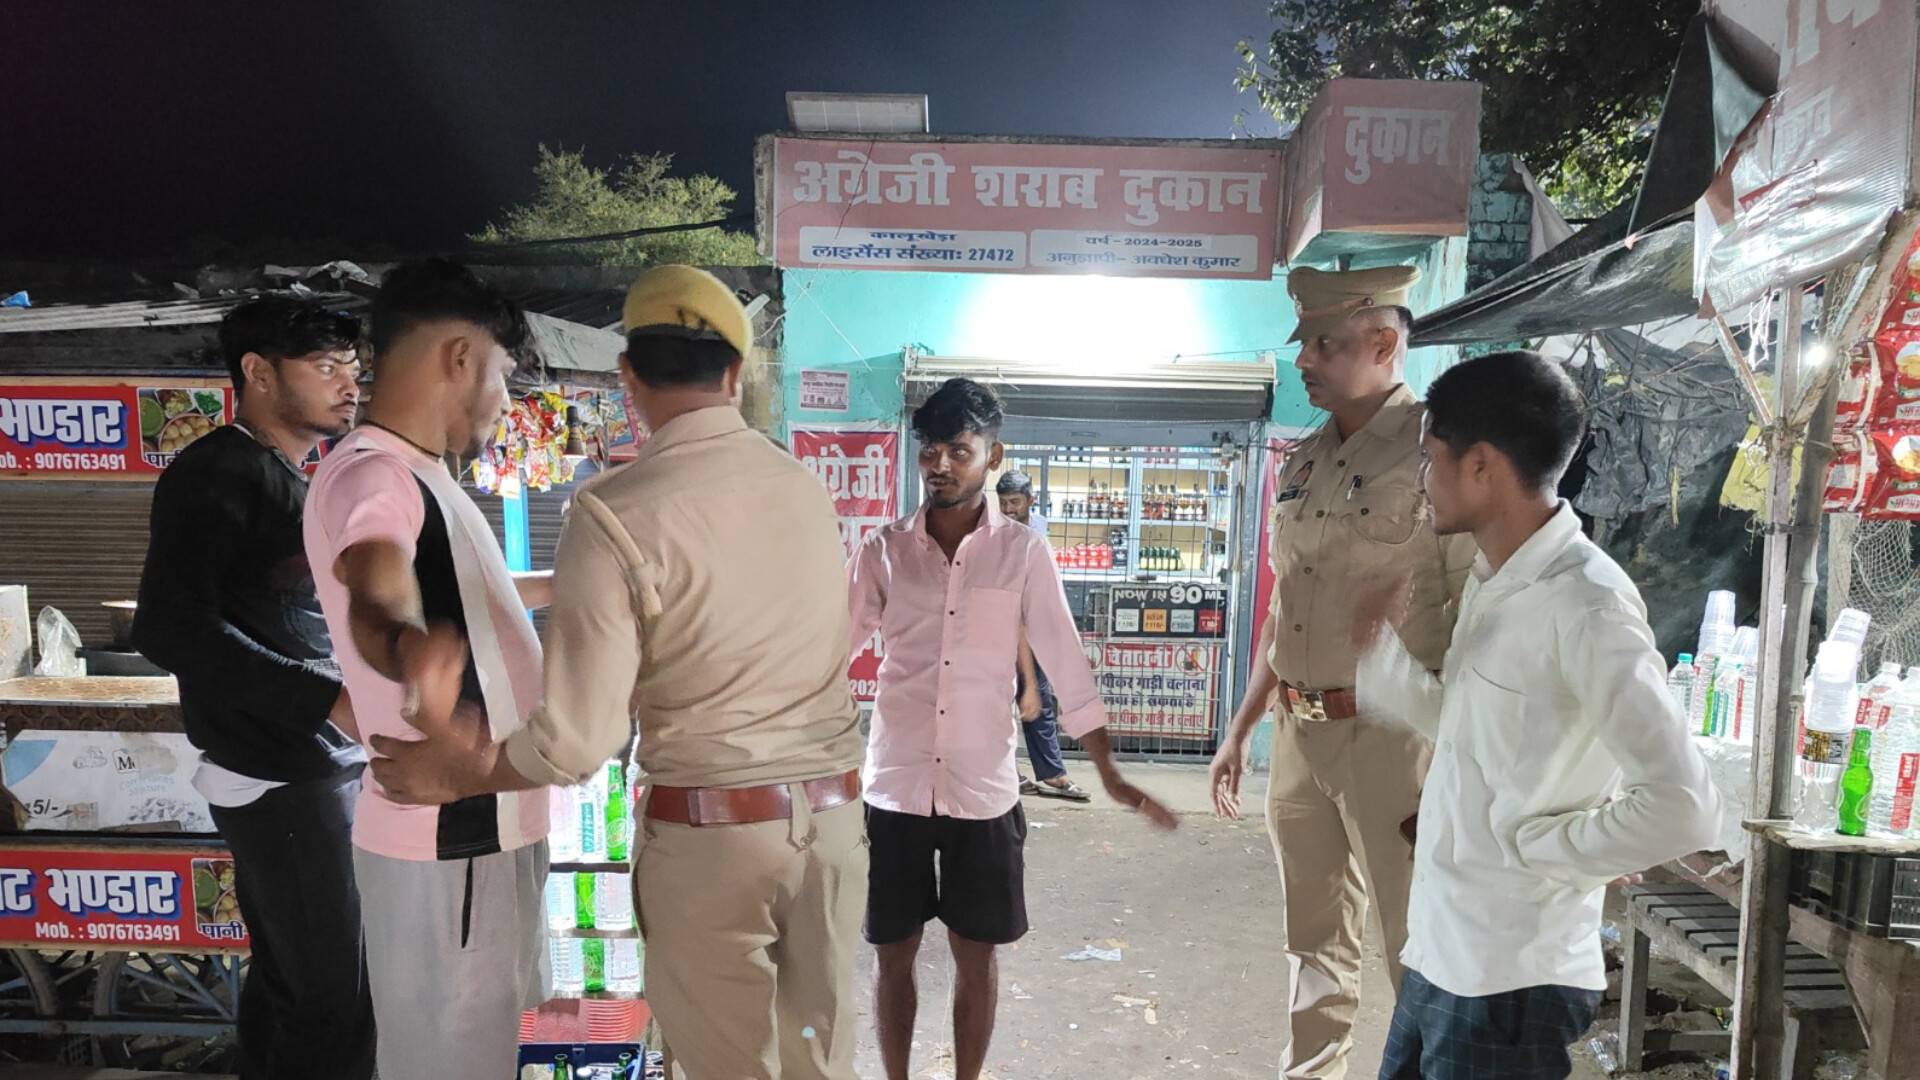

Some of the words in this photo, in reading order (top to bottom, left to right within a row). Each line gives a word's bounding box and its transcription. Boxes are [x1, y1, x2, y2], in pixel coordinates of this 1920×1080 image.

[1343, 106, 1457, 185] दुकान
[971, 164, 1105, 210] शराब
[1119, 168, 1268, 226] दुकान
[1085, 234, 1110, 245] वर्ष
[1124, 237, 1203, 248] 2024-2025
[811, 243, 892, 260] लाइसेंस
[968, 248, 1014, 261] 27472
[1193, 255, 1241, 269] कुमार
[0, 397, 124, 444] भण्डार
[0, 451, 22, 469] ob.
[34, 452, 127, 471] 9076763491
[1114, 589, 1149, 604] NOW
[1151, 589, 1167, 603] IN
[1169, 585, 1203, 605] 90
[1204, 590, 1225, 601] ML
[1107, 646, 1172, 667] चेतावनी
[44, 867, 177, 915] भण्डार
[34, 921, 76, 940] Mob.
[87, 921, 181, 942] 9076763491
[200, 920, 245, 940] पानी
